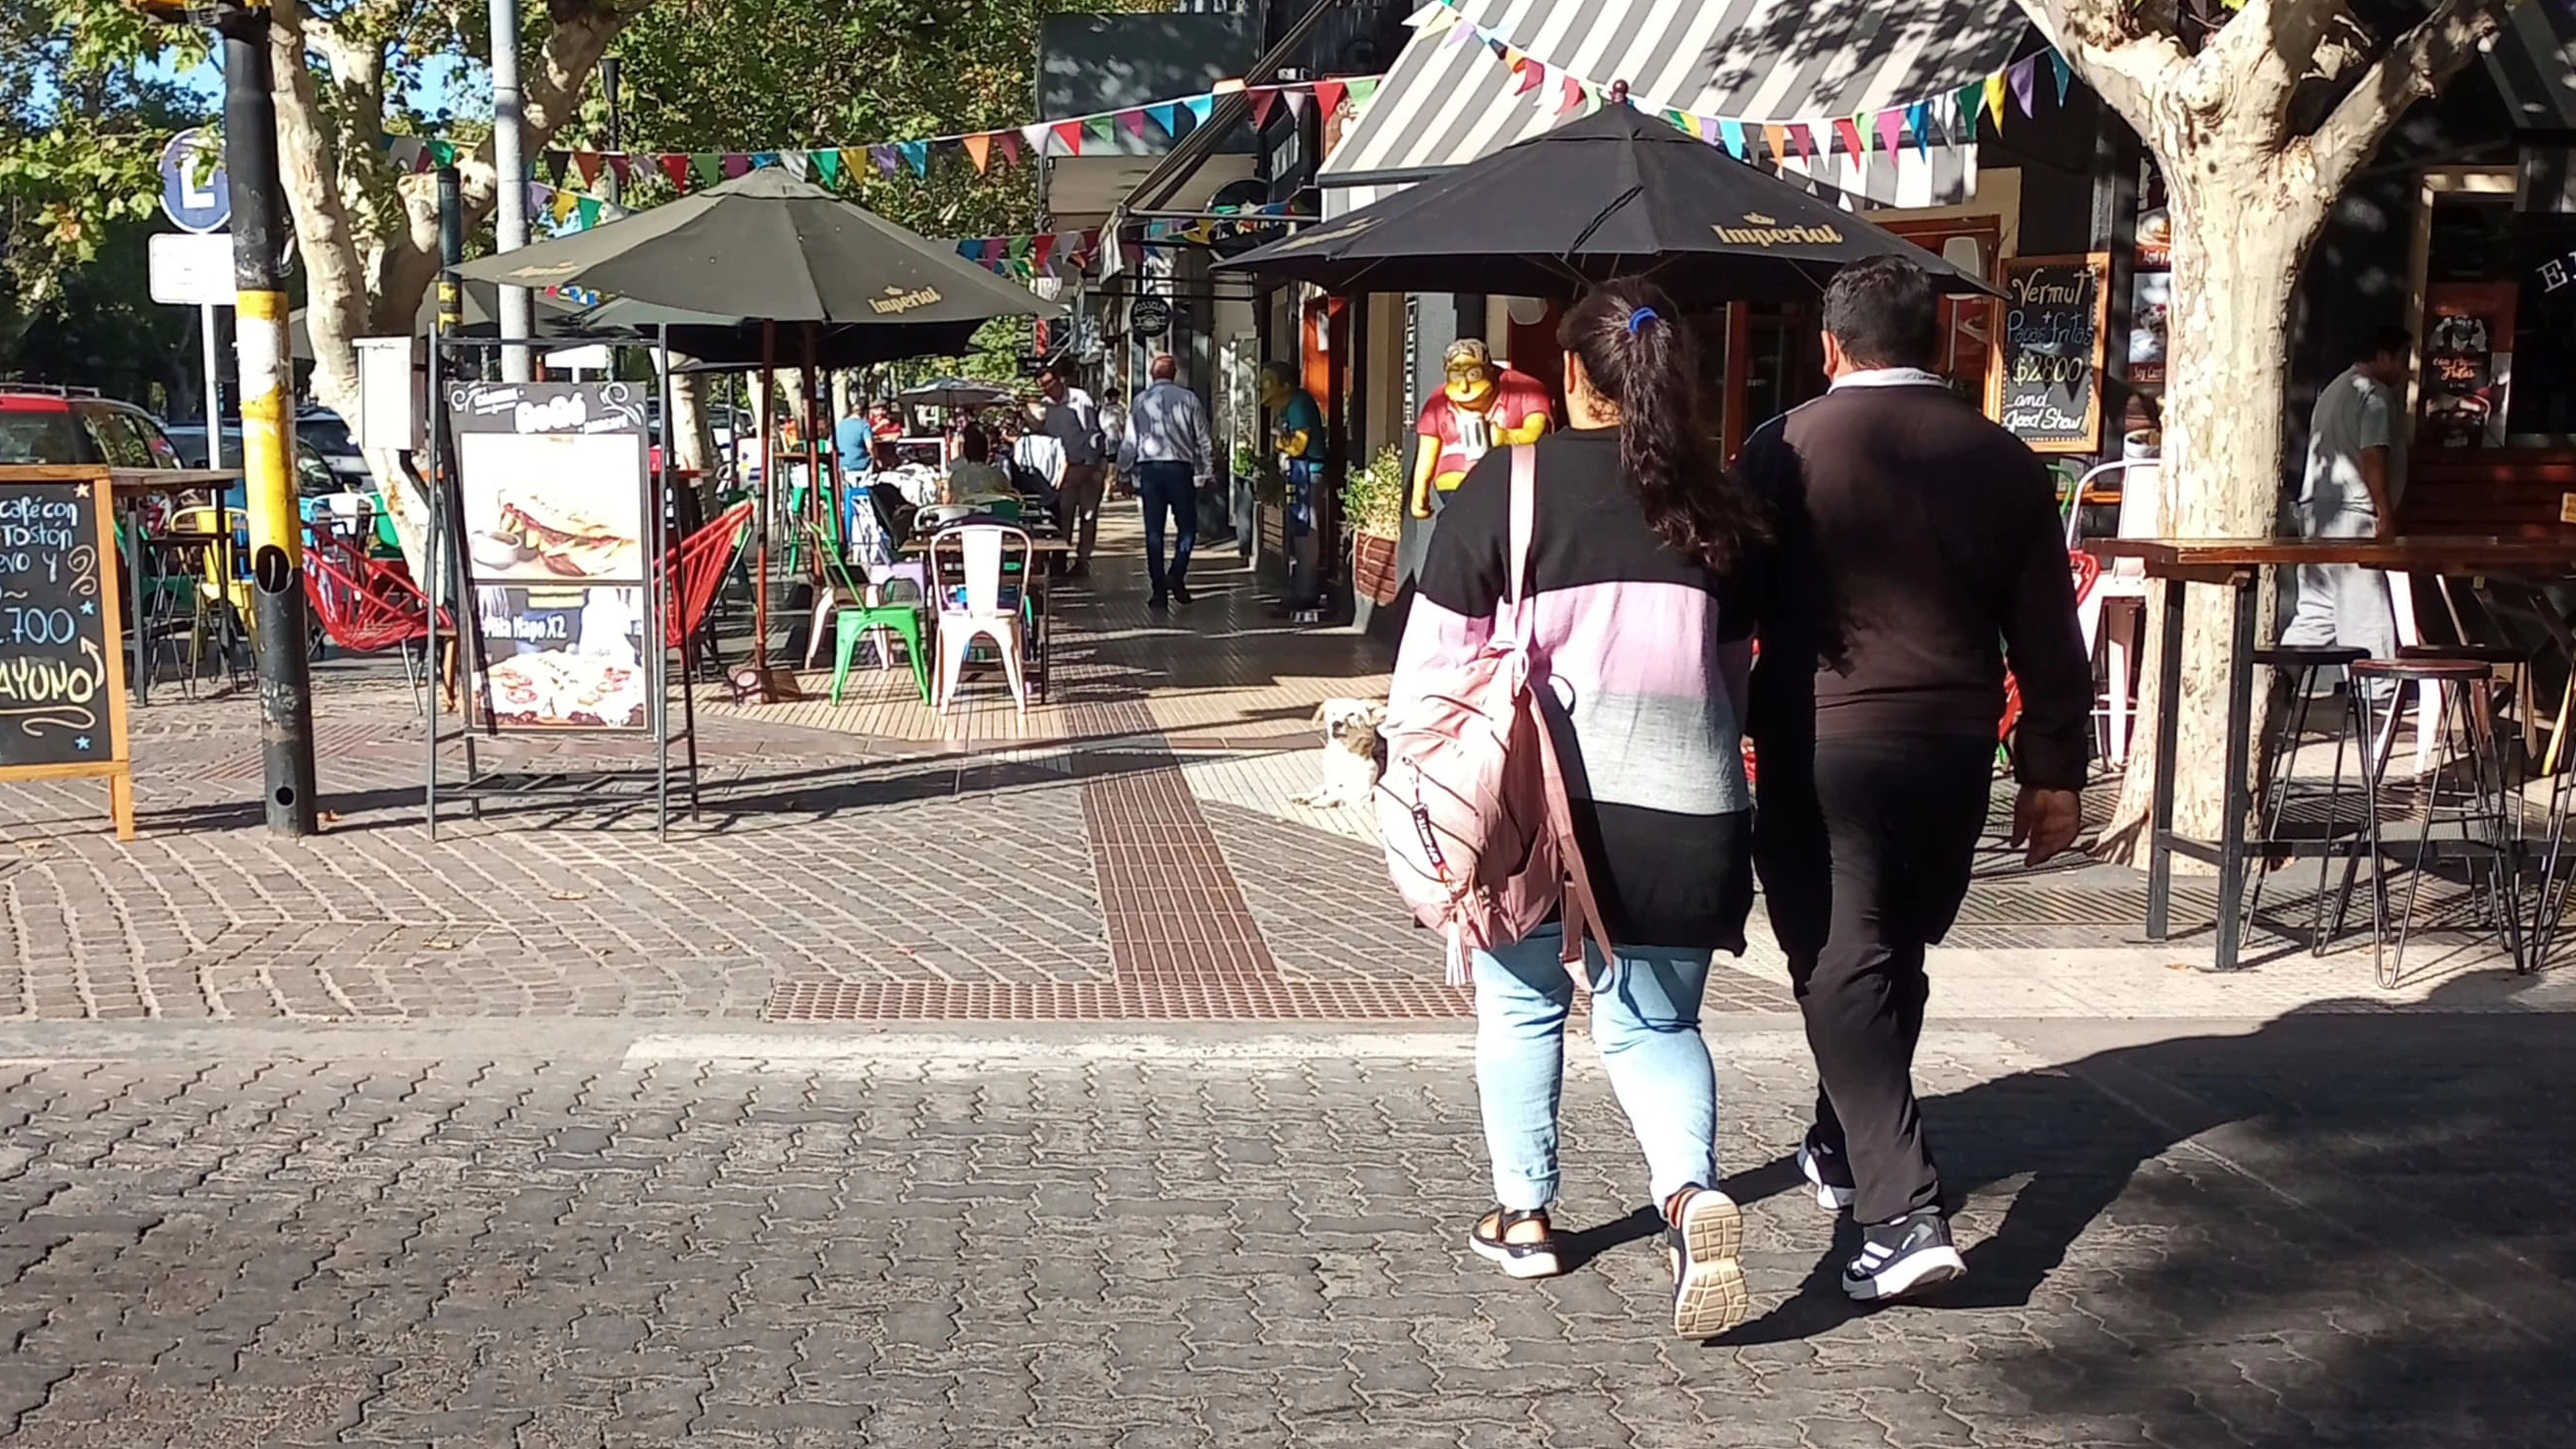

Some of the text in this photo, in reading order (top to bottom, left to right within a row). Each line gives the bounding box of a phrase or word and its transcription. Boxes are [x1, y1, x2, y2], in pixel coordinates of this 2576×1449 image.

[1710, 224, 1843, 247] Imperial
[2535, 250, 2576, 292] E
[868, 286, 941, 313] Imperial
[2012, 268, 2092, 307] Vermut
[2011, 354, 2083, 386] $2800
[43, 502, 77, 526] con
